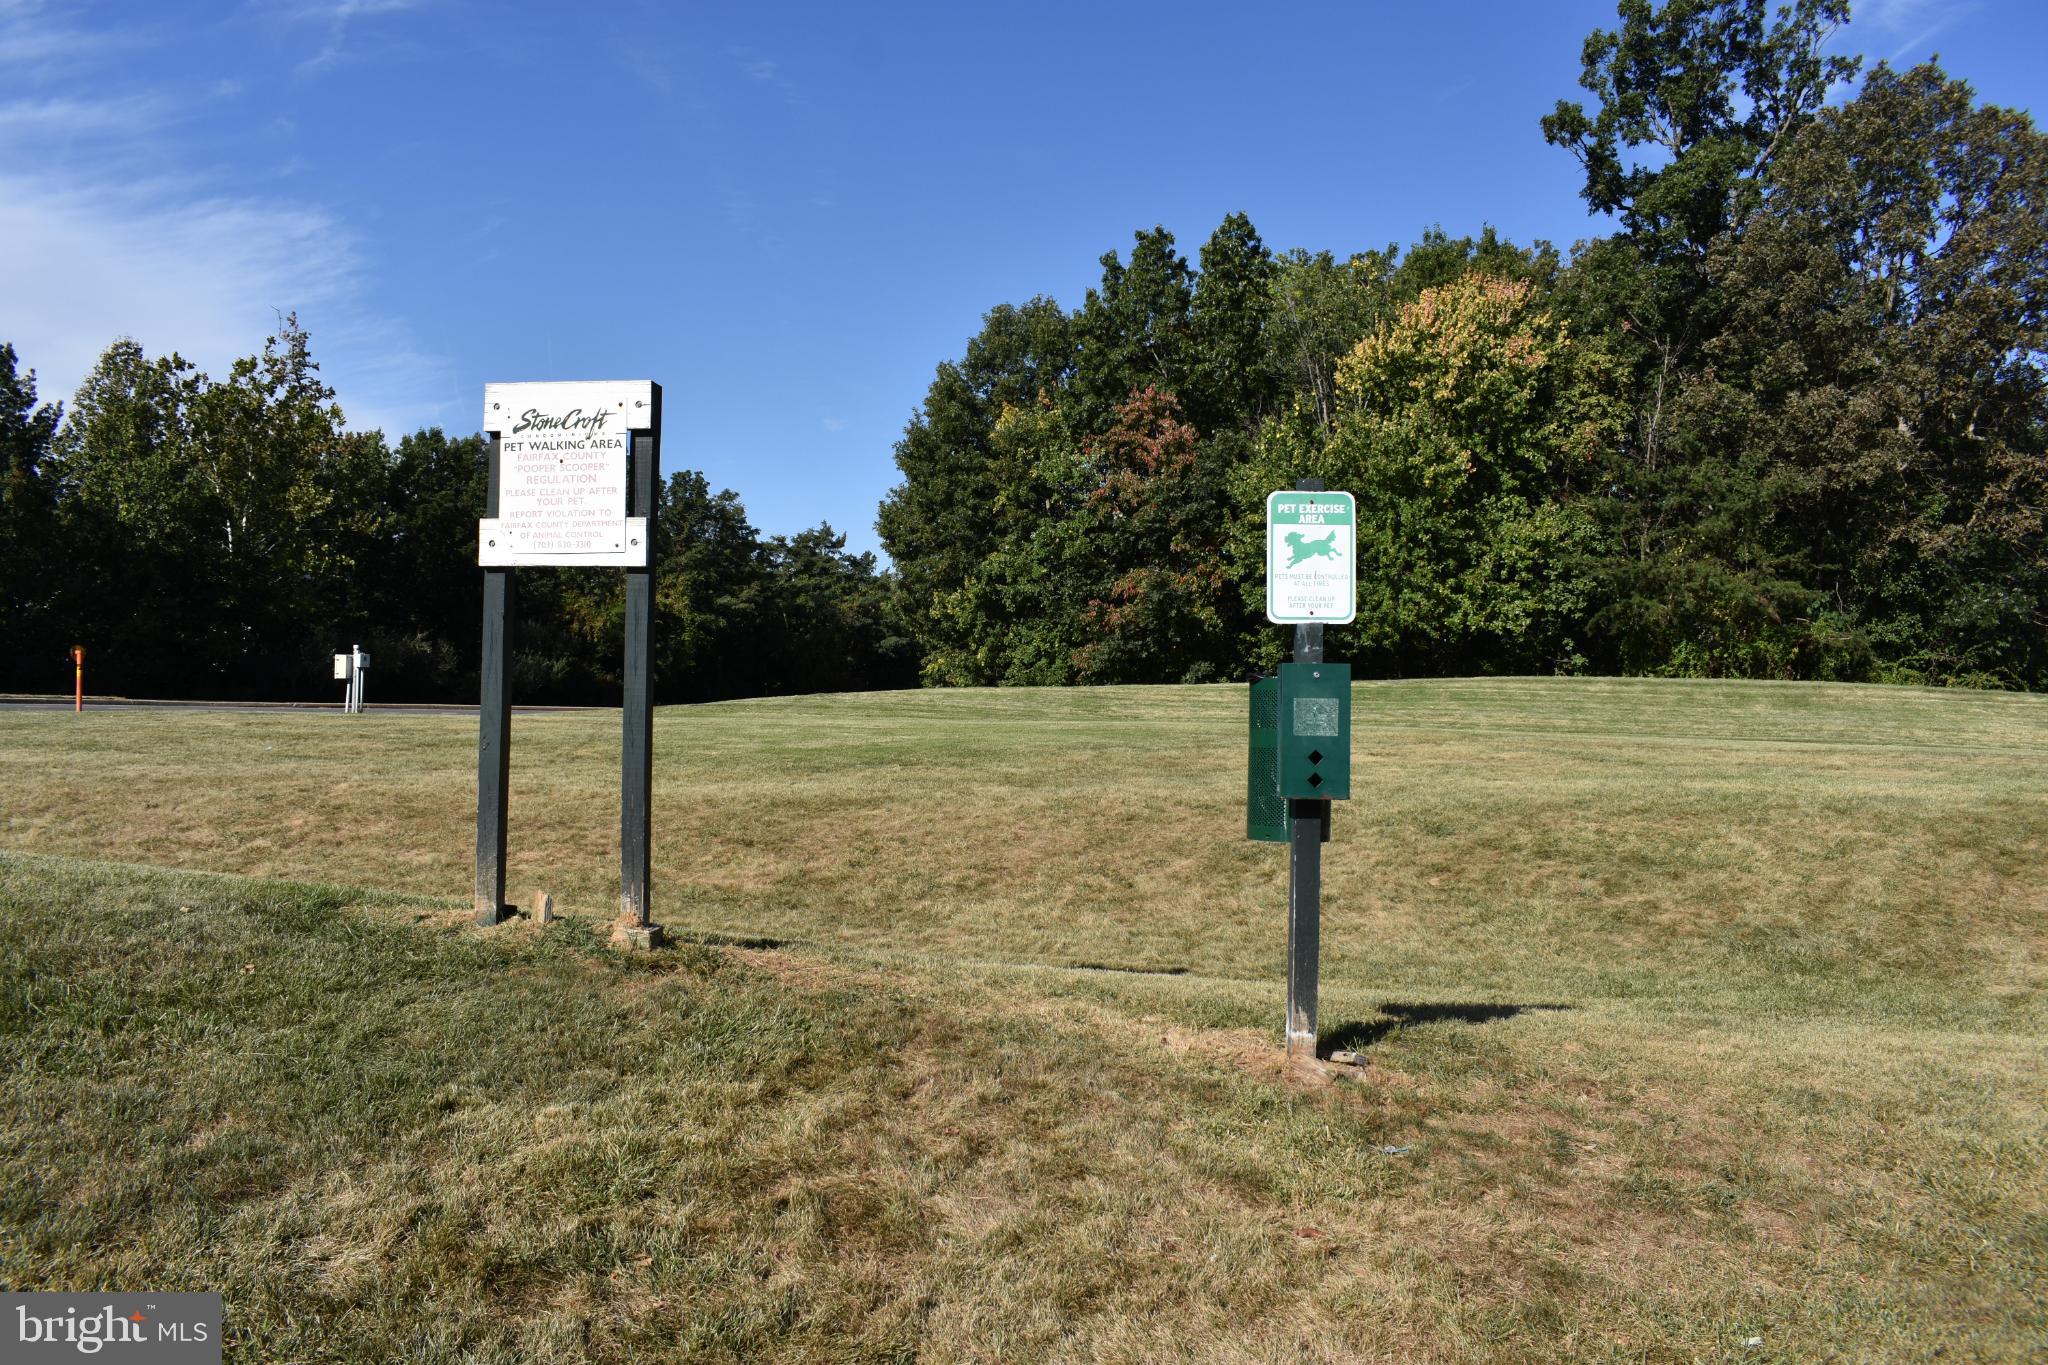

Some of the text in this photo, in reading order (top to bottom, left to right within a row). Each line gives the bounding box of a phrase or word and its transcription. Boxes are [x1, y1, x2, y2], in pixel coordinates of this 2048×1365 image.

[512, 407, 617, 440] StoneCroft
[504, 439, 623, 452] PET WALKING AREA
[517, 451, 607, 462] FAIRFAX COUNTY
[526, 473, 597, 485] REGULATION
[505, 486, 618, 497] PLEASE CLEAN UP AFTER
[536, 497, 563, 506] YOUR
[510, 509, 612, 519] REPORT VIOLATION TO
[1277, 504, 1346, 514] PET EXERCISE
[500, 519, 623, 529] FAIRFAX COUNTY DEPARTMENT
[1298, 514, 1325, 524] AREA
[532, 531, 562, 539] ANIMAL
[565, 530, 604, 538] CONTROL
